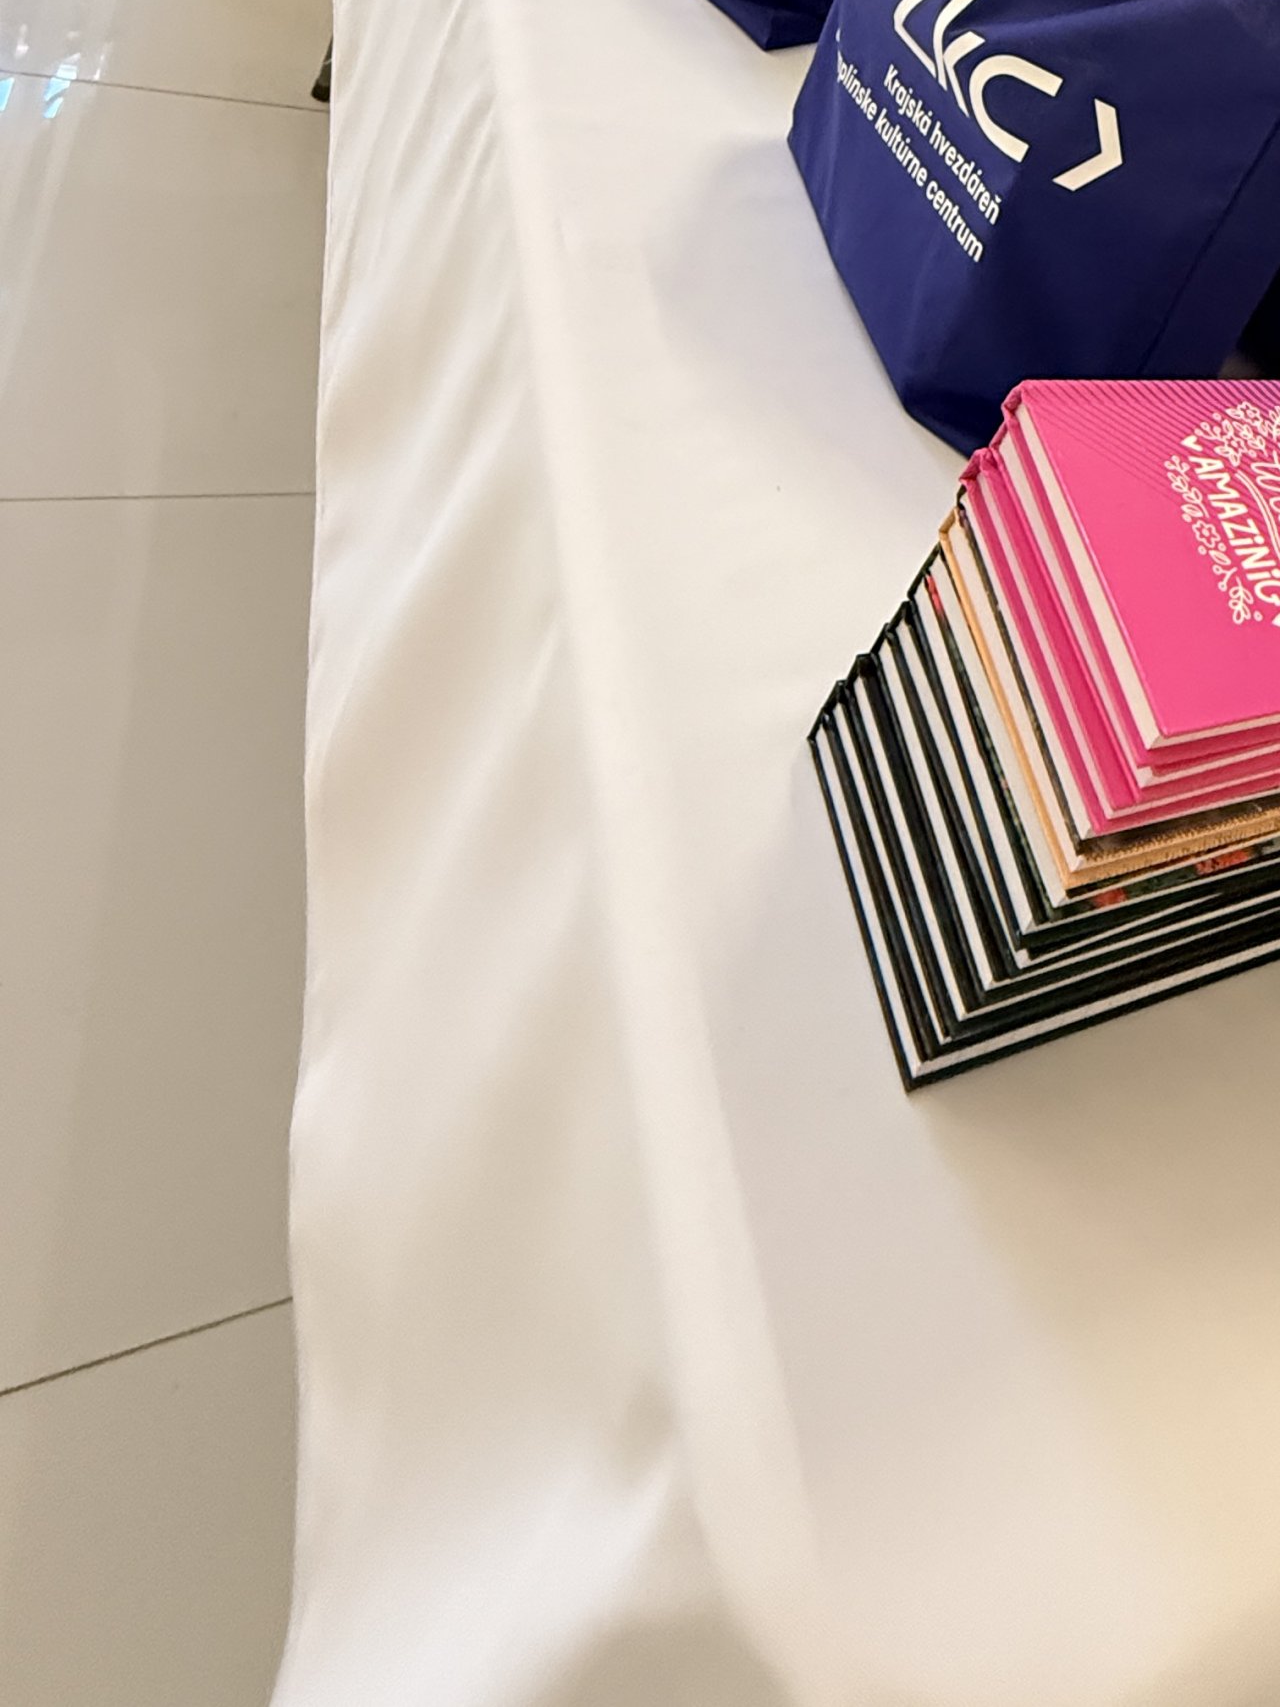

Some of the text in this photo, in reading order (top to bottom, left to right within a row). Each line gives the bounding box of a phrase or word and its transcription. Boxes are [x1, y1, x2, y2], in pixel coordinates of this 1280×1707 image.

[874, 108, 928, 187] kultúrne
[926, 180, 984, 263] centrum
[884, 64, 1002, 225] Krajská hvezdáreň
